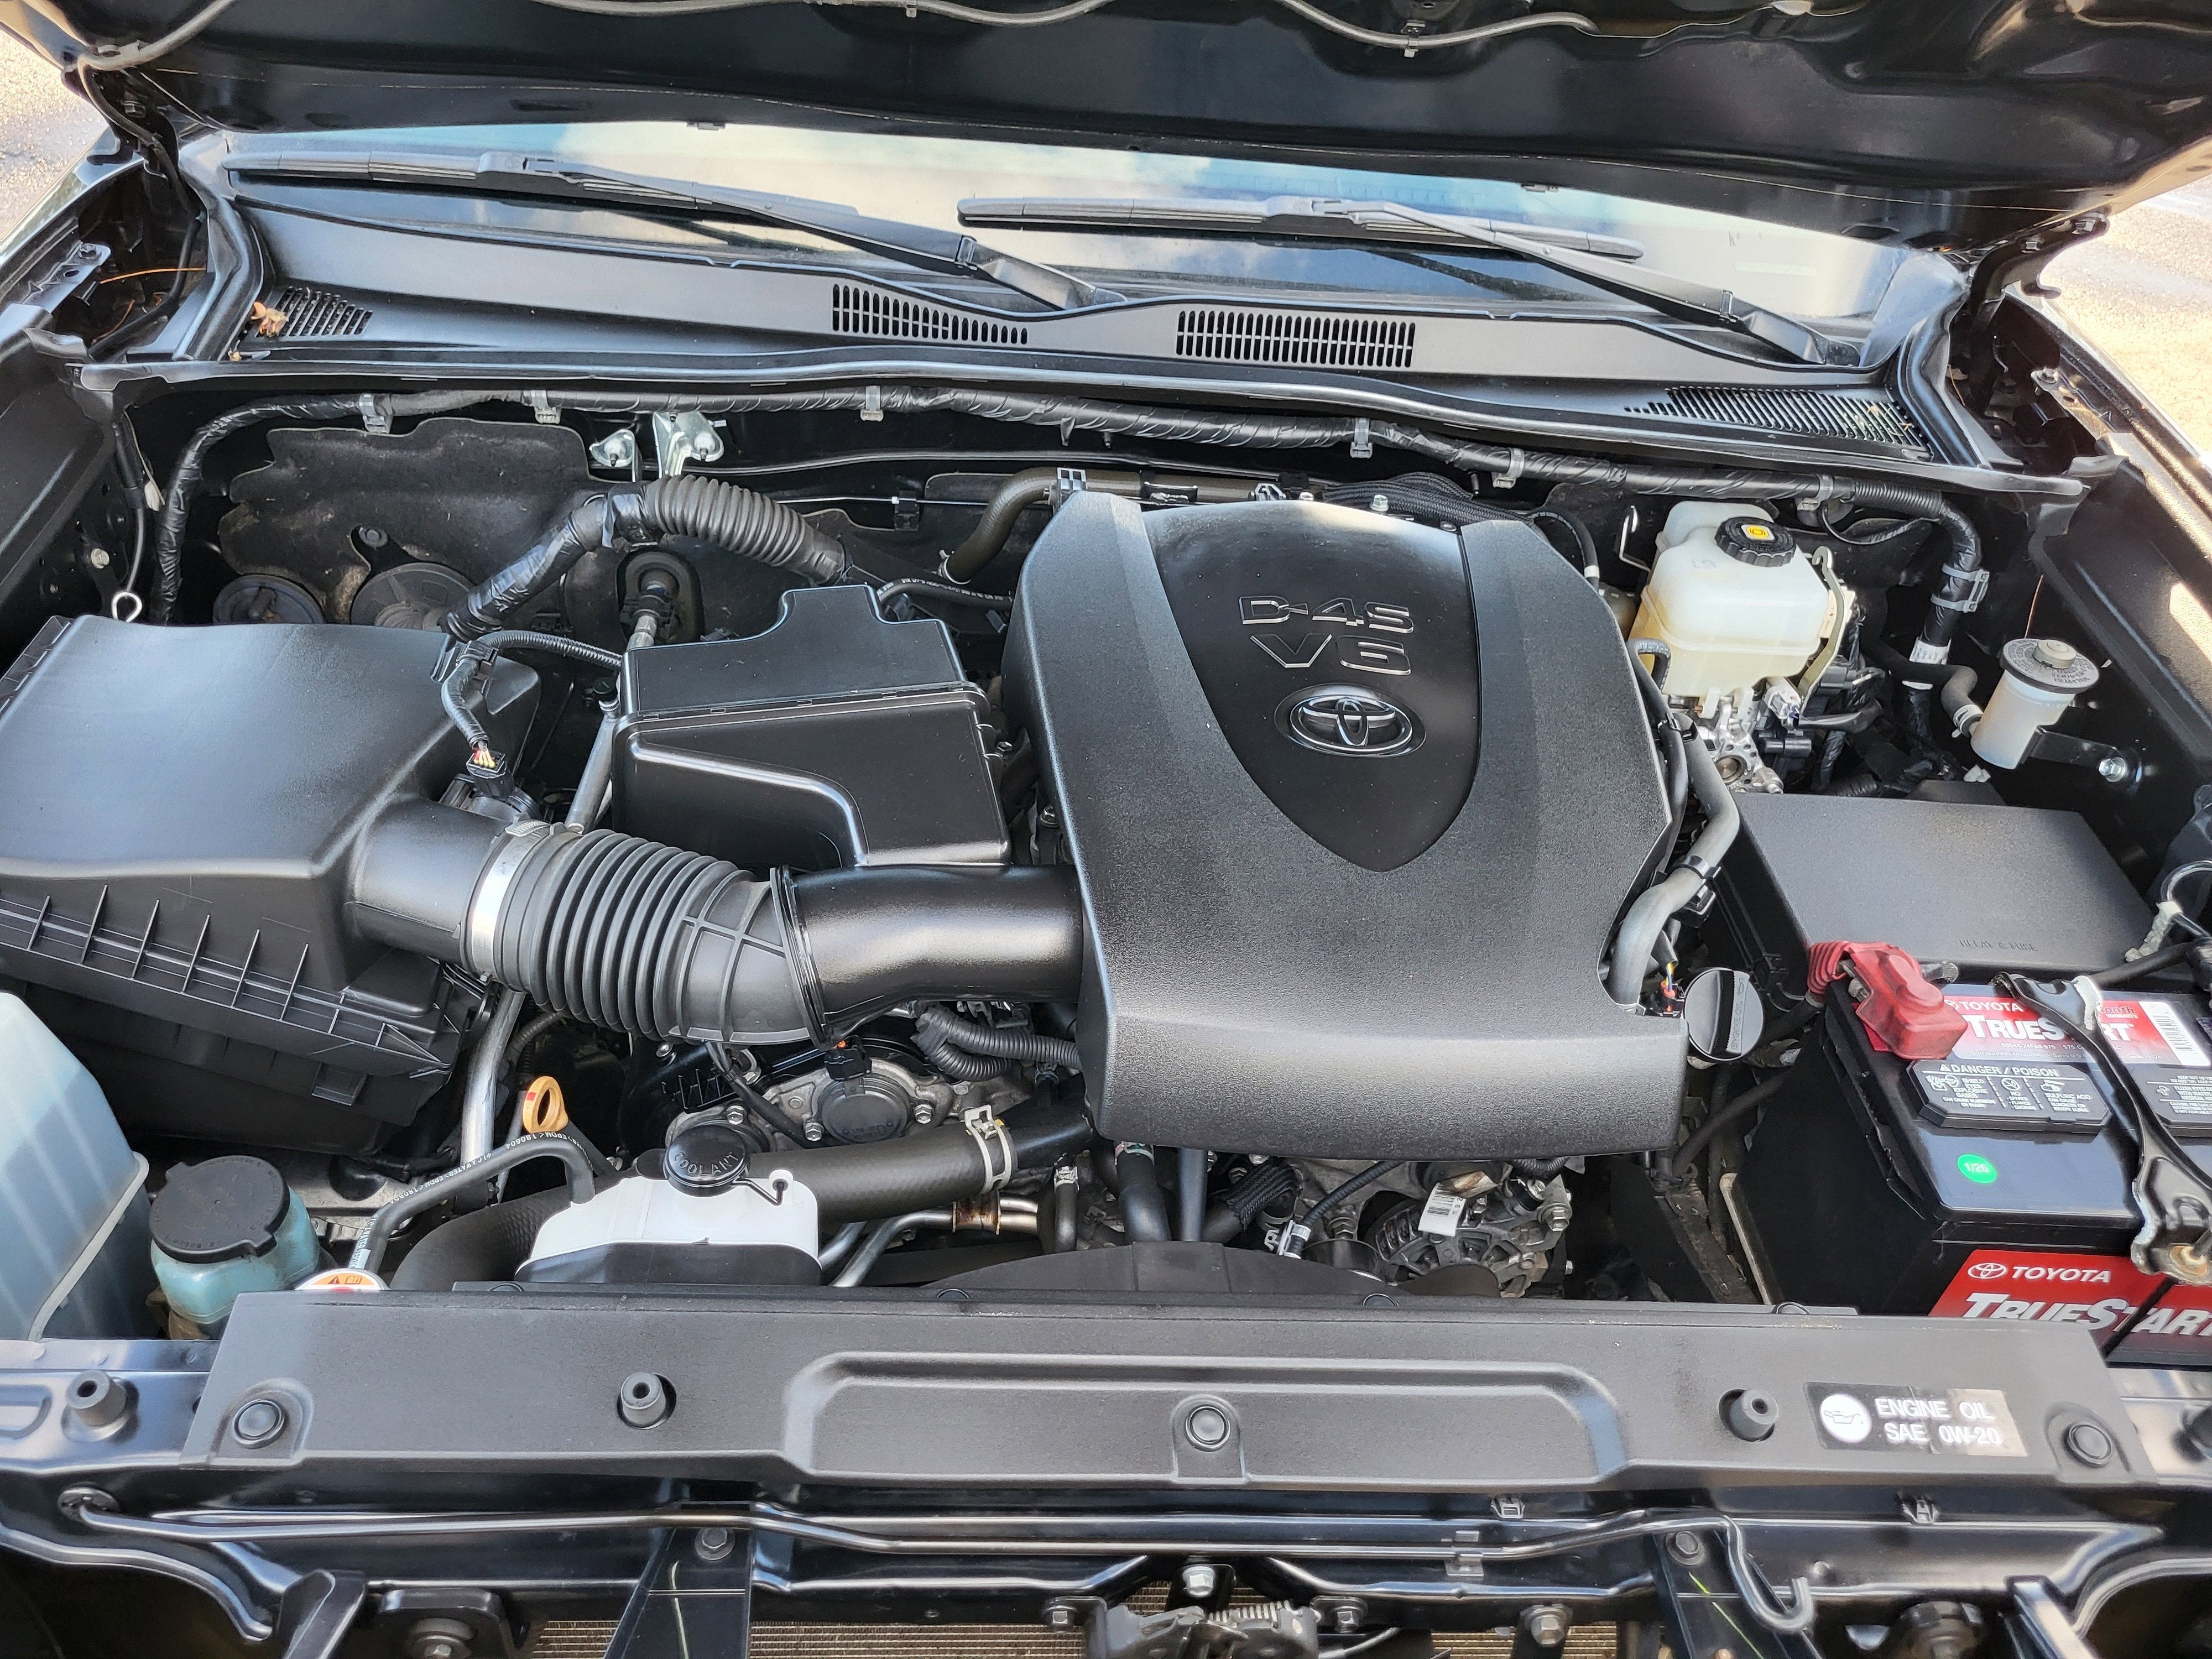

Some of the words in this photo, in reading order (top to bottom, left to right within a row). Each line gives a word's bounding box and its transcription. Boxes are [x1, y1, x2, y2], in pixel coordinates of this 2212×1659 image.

[1249, 633, 1412, 676] V6
[1959, 939, 1994, 949] RELAY
[2008, 941, 2039, 952] FUSE
[1735, 1000, 1743, 1015] OIL
[1958, 1000, 2024, 1013] TOYOTA
[2101, 1005, 2136, 1014] onth
[1731, 1016, 1741, 1050] ENGINE
[1950, 1064, 2002, 1074] DANGER
[2011, 1067, 2059, 1077] POISON
[673, 1151, 739, 1176] COOLANT
[2011, 1266, 2111, 1284] TOYOTA
[1874, 1398, 1950, 1418] ENGINE
[1958, 1401, 1996, 1421] OIL
[1884, 1422, 1929, 1442] SAE
[1938, 1425, 2003, 1446] 0W-20
